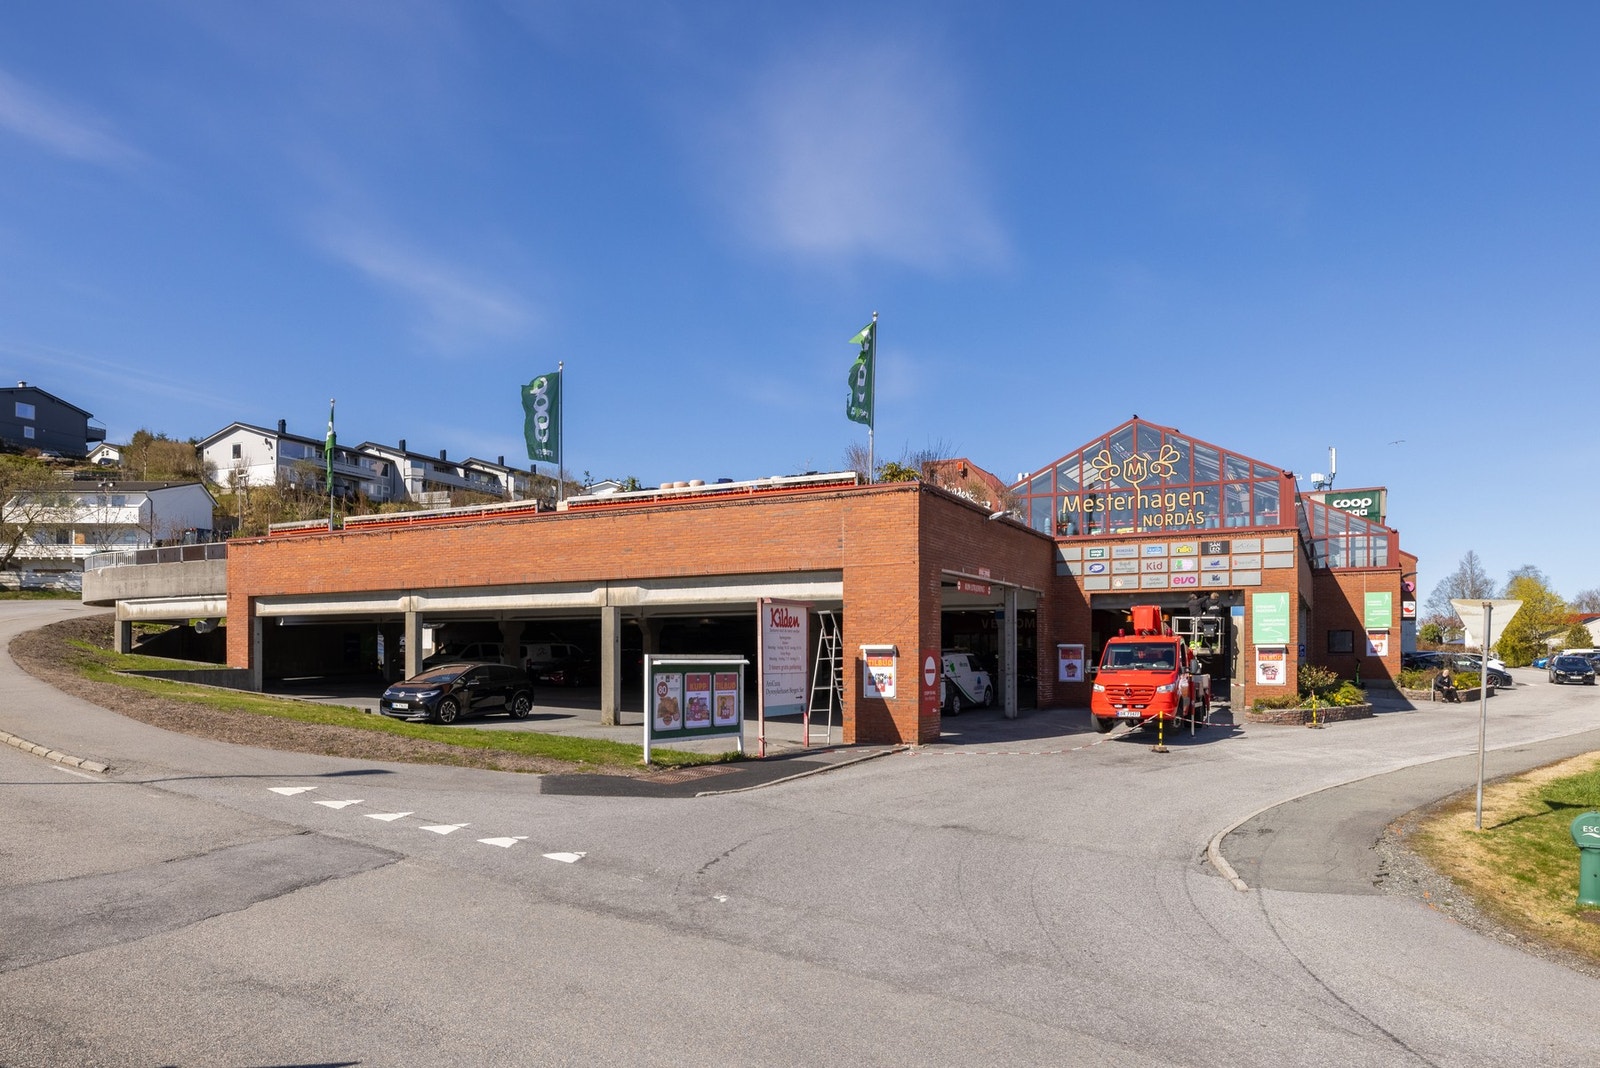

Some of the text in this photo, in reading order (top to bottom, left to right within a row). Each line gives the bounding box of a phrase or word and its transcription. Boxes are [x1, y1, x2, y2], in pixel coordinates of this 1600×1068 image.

[1127, 462, 1143, 477] M
[1062, 487, 1206, 514] Mesterhagen
[1332, 497, 1372, 509] coop
[1143, 509, 1205, 527] NORDÅS
[1146, 562, 1163, 571] Kid
[1173, 576, 1196, 585] evo
[770, 607, 800, 628] Kilden
